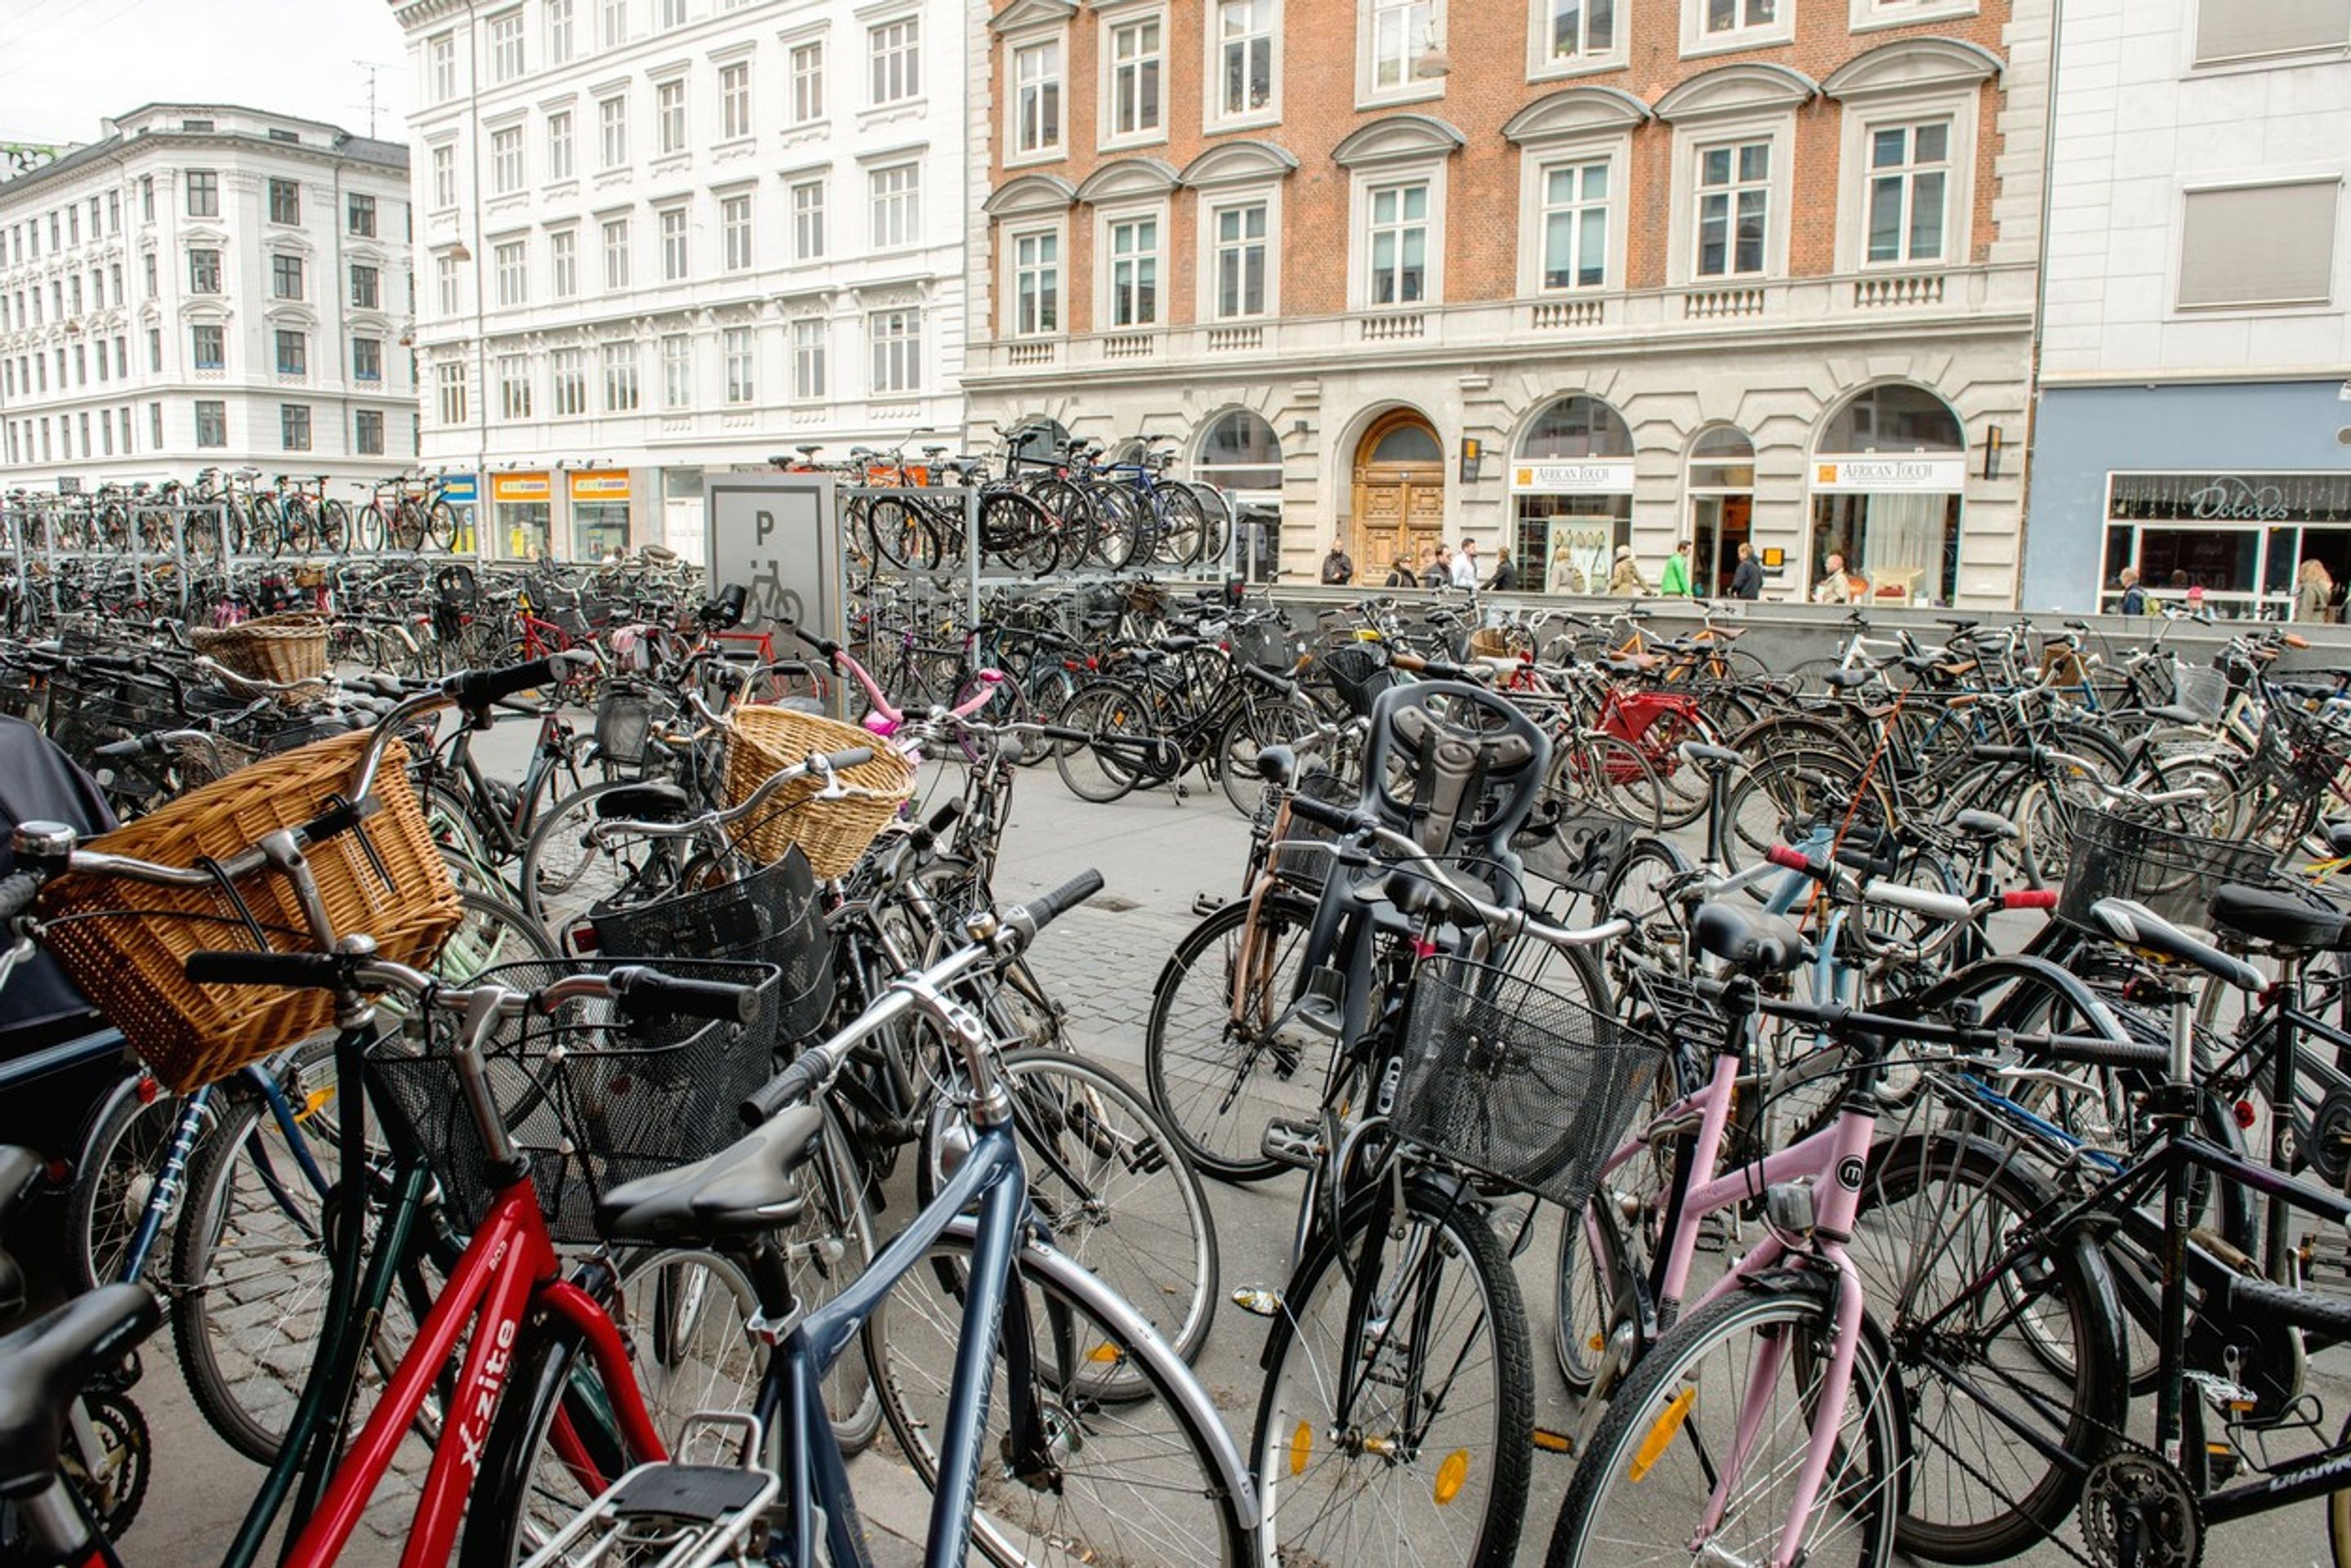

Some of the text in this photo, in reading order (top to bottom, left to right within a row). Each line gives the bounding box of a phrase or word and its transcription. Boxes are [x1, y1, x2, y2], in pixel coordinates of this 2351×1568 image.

[1894, 461, 1933, 478] TOUCH
[2189, 476, 2288, 520] Dolores
[755, 510, 774, 546] P
[460, 1318, 516, 1477] X-zite
